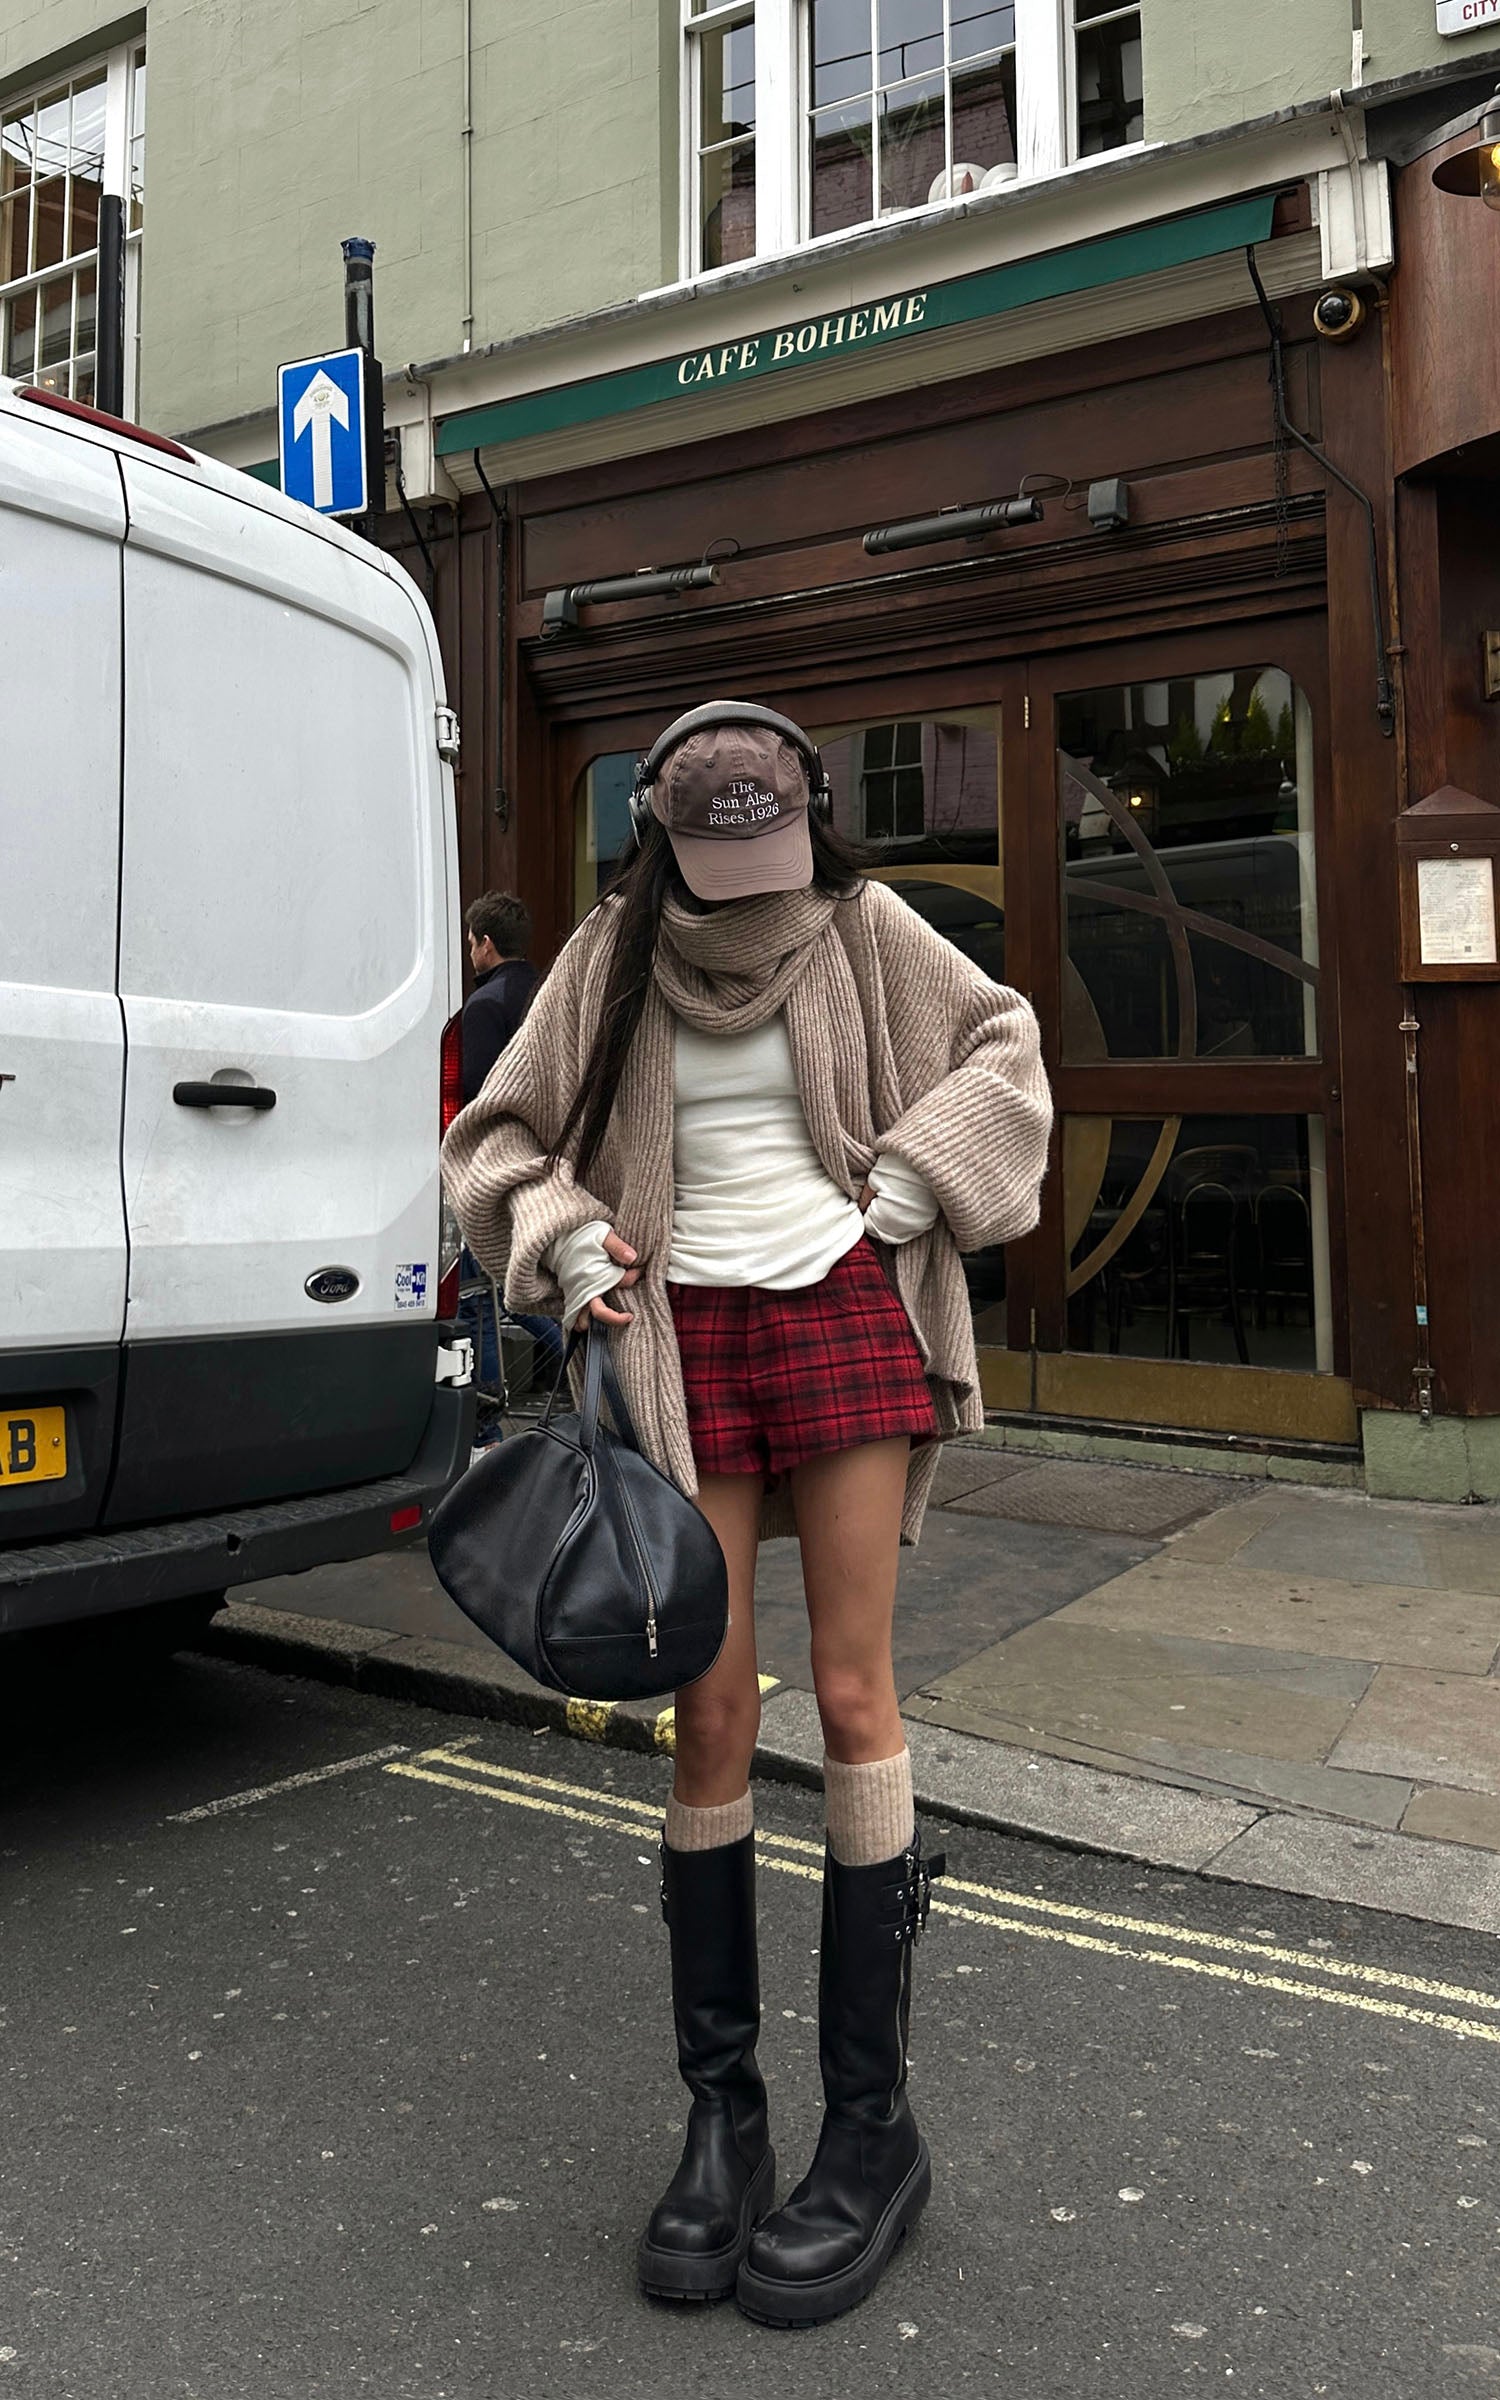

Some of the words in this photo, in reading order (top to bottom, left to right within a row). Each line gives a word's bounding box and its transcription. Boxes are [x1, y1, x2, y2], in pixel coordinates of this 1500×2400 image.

[1463, 0, 1498, 20] CITY
[677, 340, 760, 385] CAFE
[771, 293, 928, 361] BOHEME
[728, 781, 756, 795] The
[712, 797, 740, 810] Sun
[745, 792, 774, 807] Also
[320, 1276, 350, 1294] Ford
[0, 1418, 36, 1475] B
